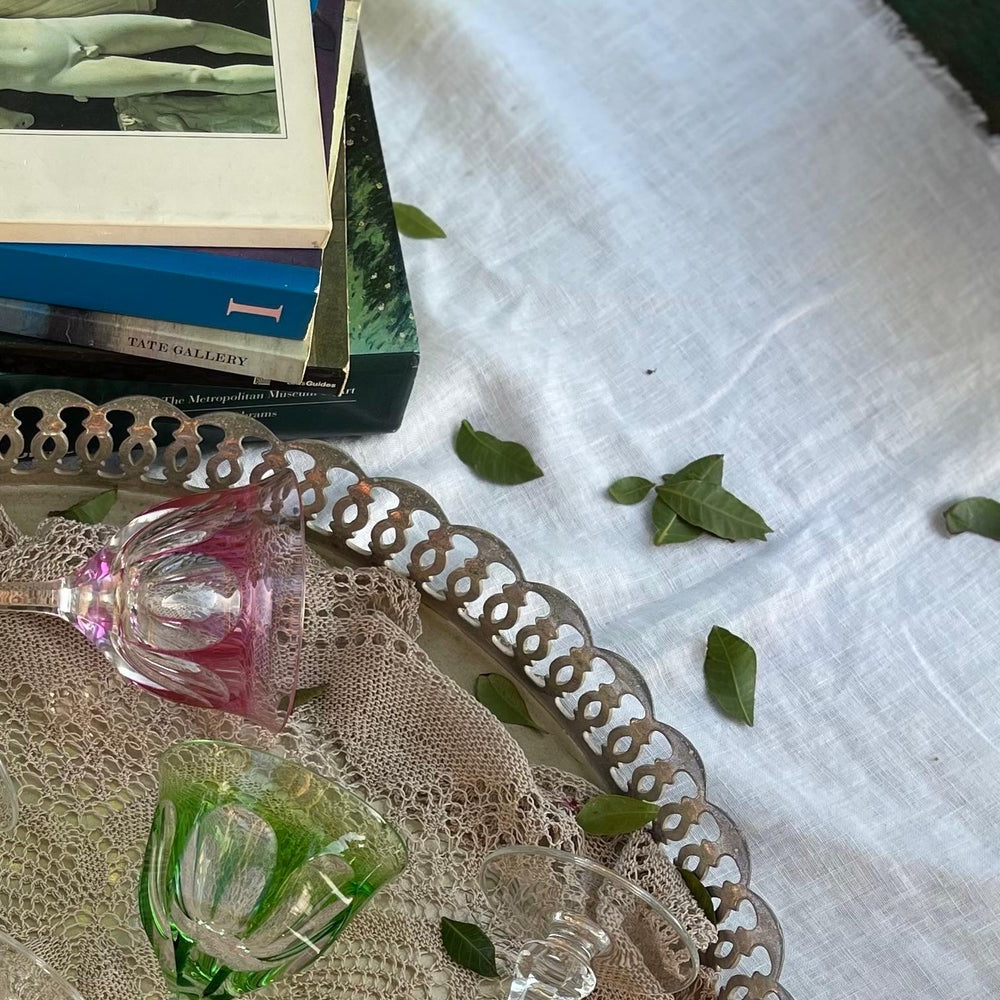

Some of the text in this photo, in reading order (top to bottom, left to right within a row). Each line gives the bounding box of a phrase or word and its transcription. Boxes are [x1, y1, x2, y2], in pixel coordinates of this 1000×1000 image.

[127, 337, 249, 367] TATE GALLERY
[162, 396, 185, 405] The
[188, 391, 264, 405] Metropolitan
